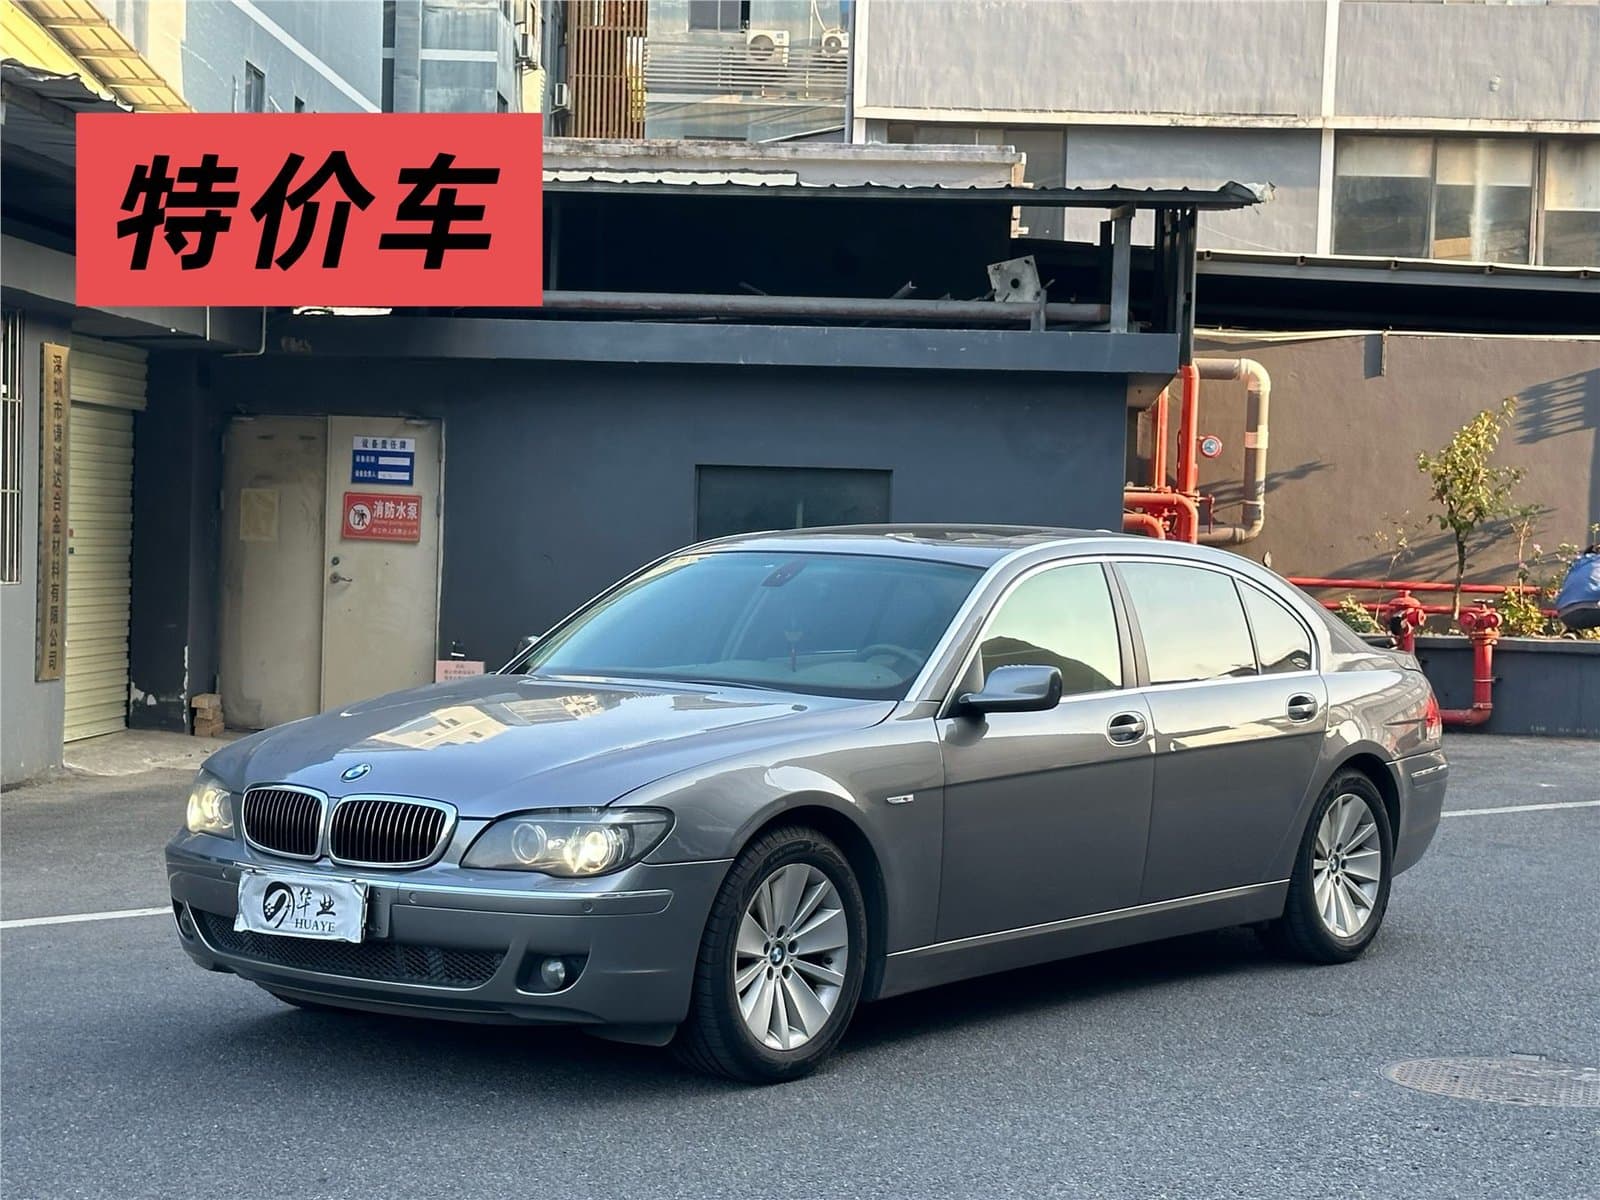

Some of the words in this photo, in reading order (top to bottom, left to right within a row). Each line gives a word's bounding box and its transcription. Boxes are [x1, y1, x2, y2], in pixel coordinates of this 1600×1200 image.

[373, 500, 418, 520] 消防水泵
[296, 886, 337, 917] 华业
[294, 917, 336, 933] HUAYE
